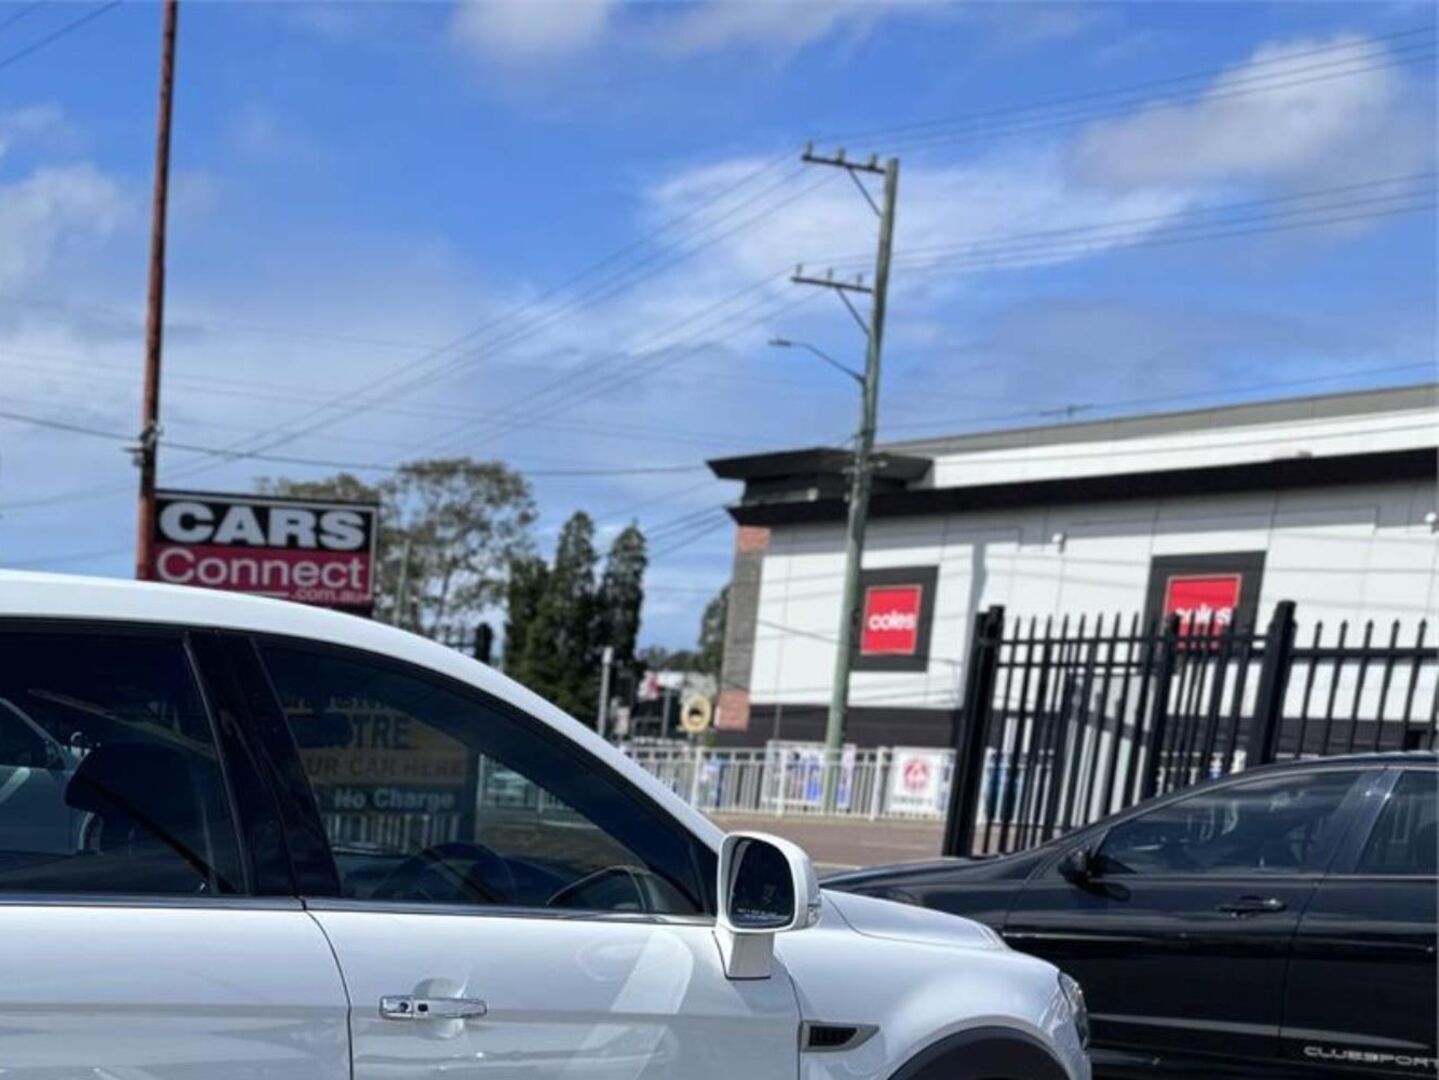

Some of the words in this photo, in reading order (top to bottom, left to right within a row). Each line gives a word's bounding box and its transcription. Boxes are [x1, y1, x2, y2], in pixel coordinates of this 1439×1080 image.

[160, 502, 366, 549] CARS
[157, 548, 363, 589] Connect
[869, 609, 917, 631] coles
[334, 788, 366, 808] No
[373, 788, 454, 812] Charge
